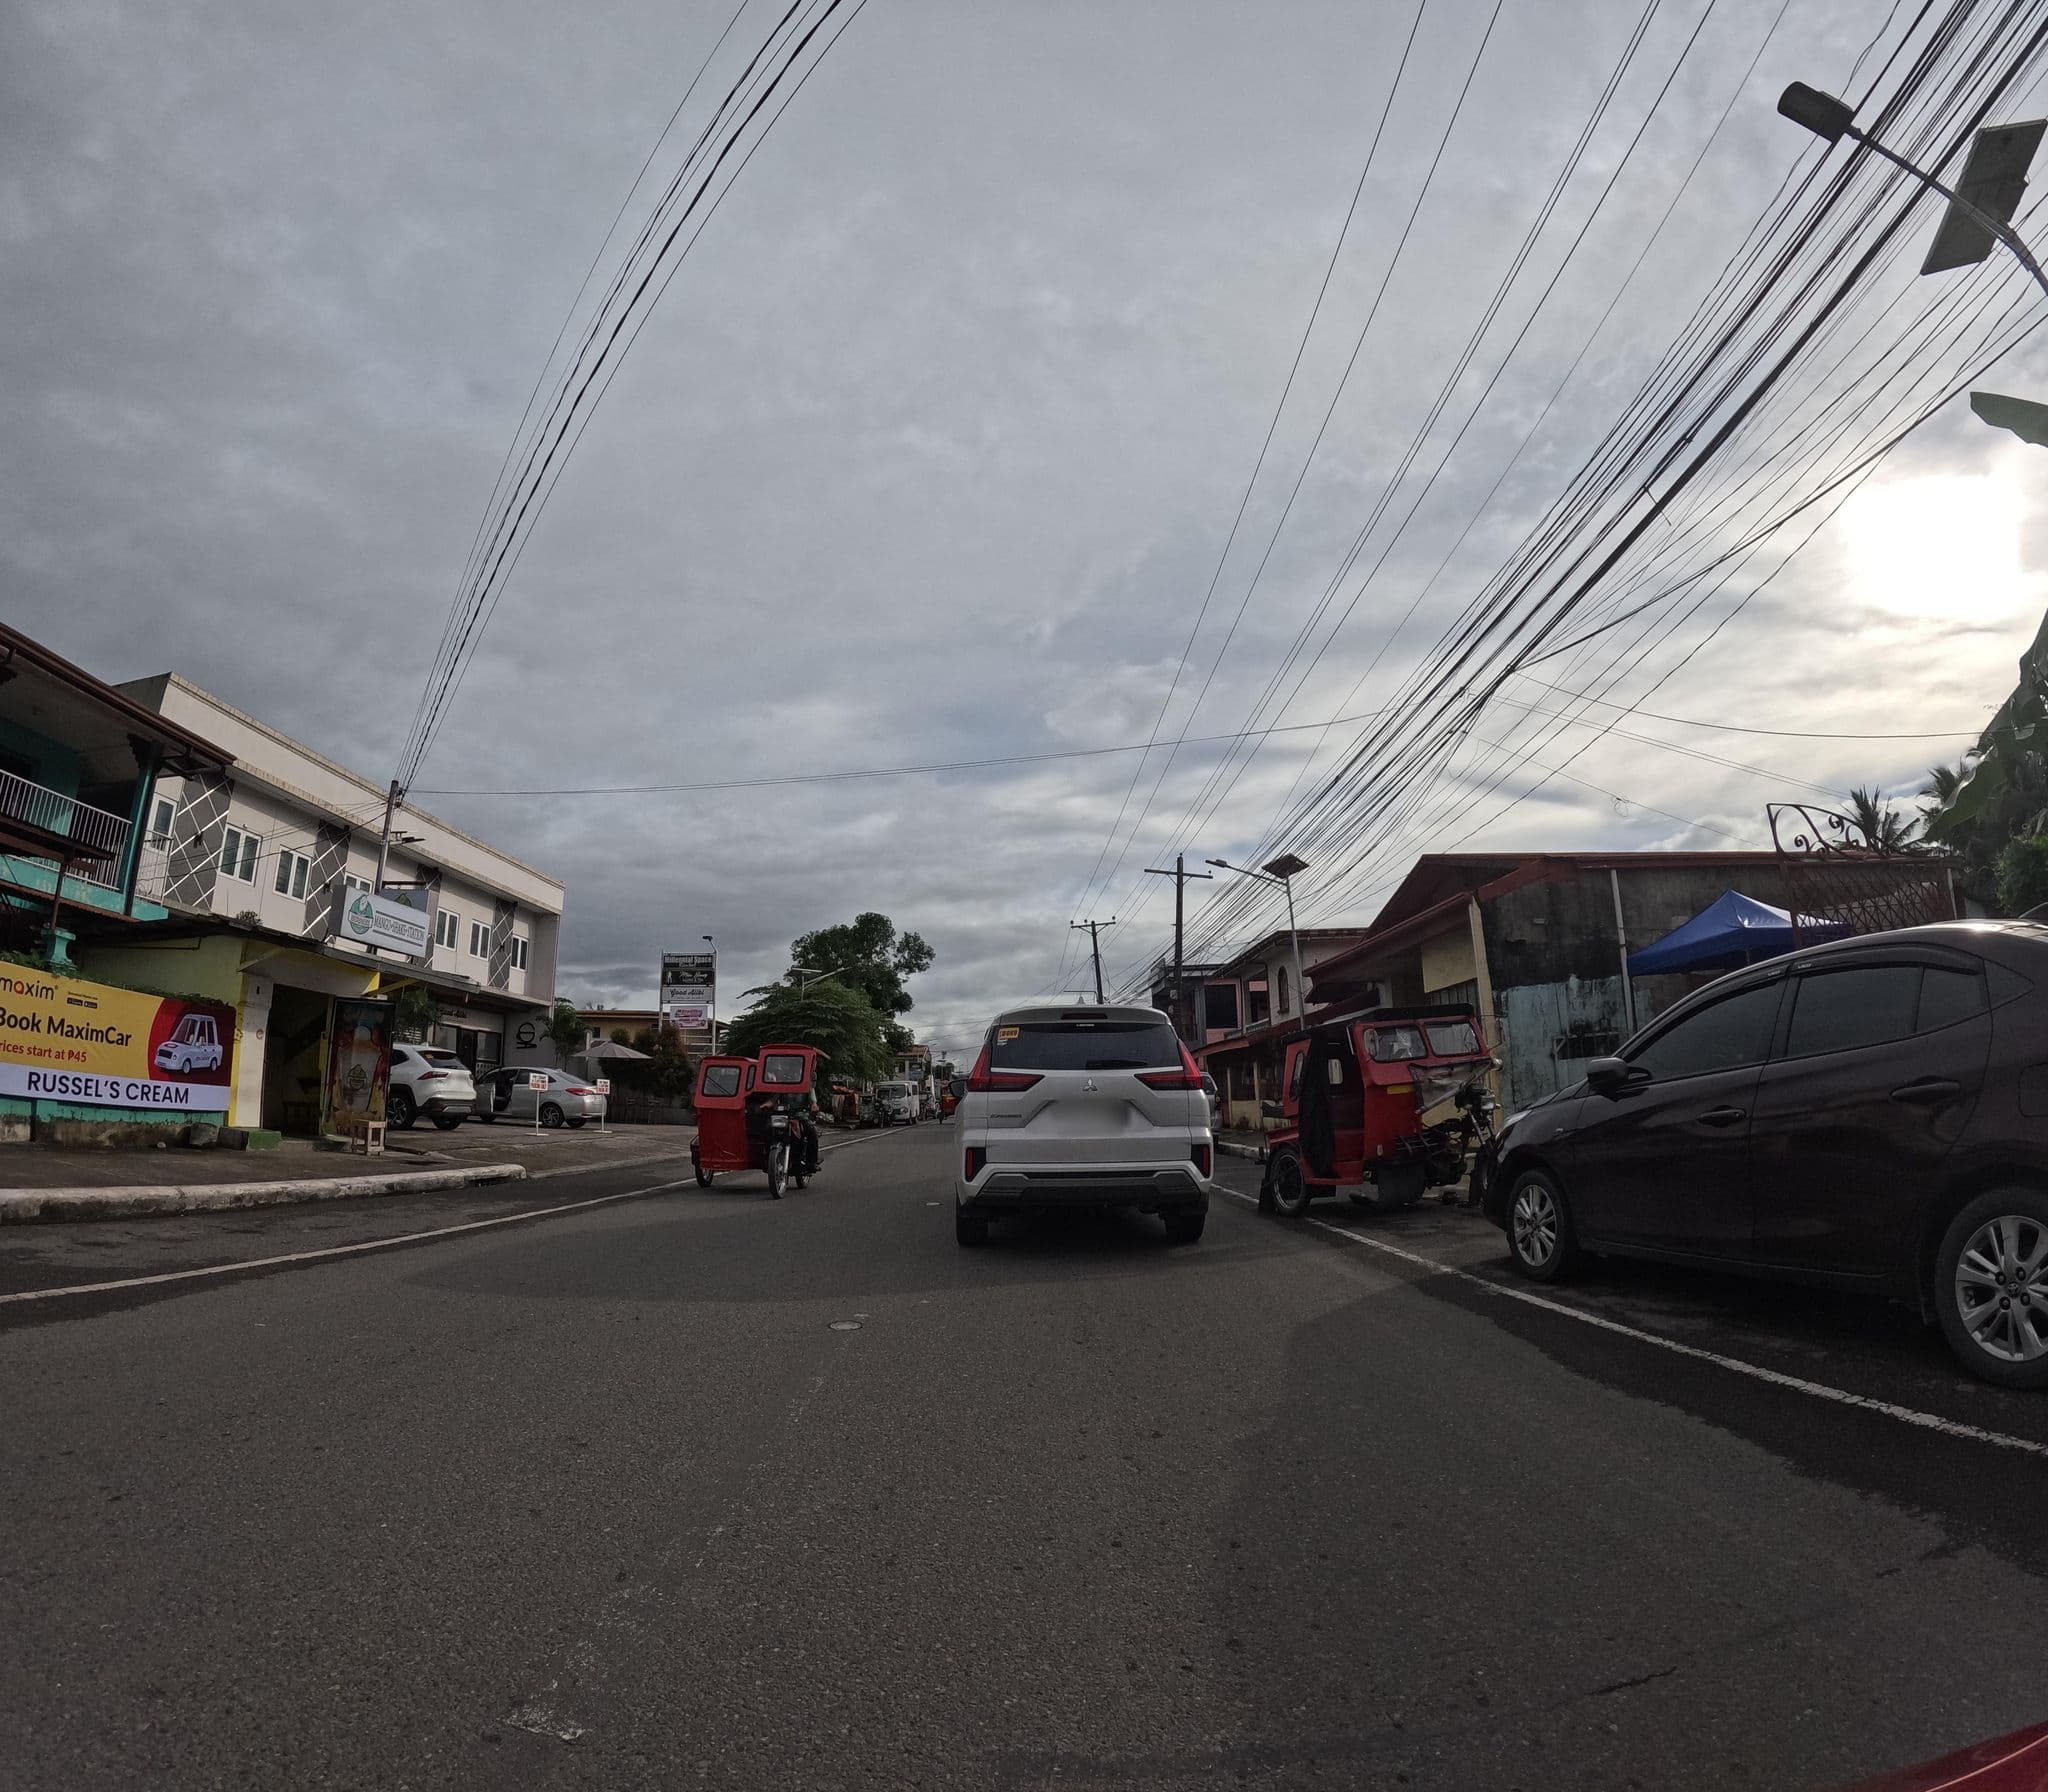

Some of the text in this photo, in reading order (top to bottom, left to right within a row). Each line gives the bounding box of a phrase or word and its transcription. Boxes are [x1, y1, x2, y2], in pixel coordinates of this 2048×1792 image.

[0, 977, 55, 1000] maxim
[0, 1006, 132, 1046] Book MaximCar
[0, 1039, 24, 1054] rices
[26, 1045, 52, 1058] start
[54, 1049, 66, 1060] at
[28, 1071, 190, 1104] RUSSEL'S CREAM
